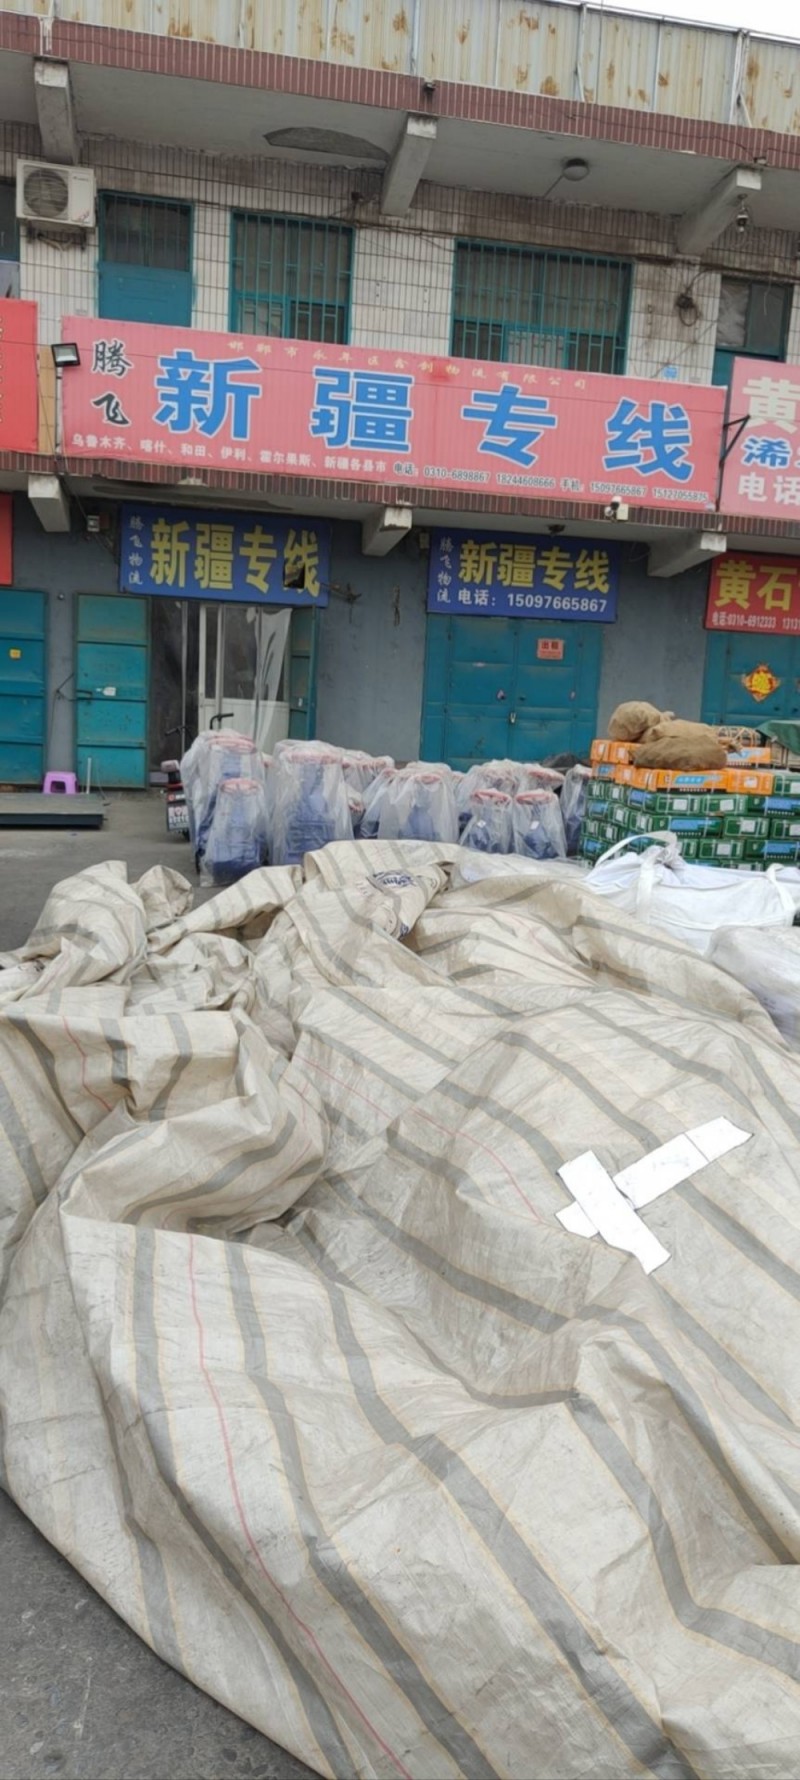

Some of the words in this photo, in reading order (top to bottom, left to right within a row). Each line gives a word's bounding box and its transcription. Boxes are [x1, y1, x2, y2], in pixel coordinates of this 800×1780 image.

[91, 338, 133, 426] 腾飞
[154, 348, 694, 482] 新疆专线
[743, 436, 800, 468] 浠
[590, 481, 647, 497] 15097665867
[128, 515, 145, 585] 腾飞物流
[150, 518, 321, 597] 新疆专线
[437, 537, 454, 604] 腾飞物流
[458, 539, 611, 594] 新疆专线
[507, 593, 608, 613] 15097665867
[714, 559, 800, 611] 黄石
